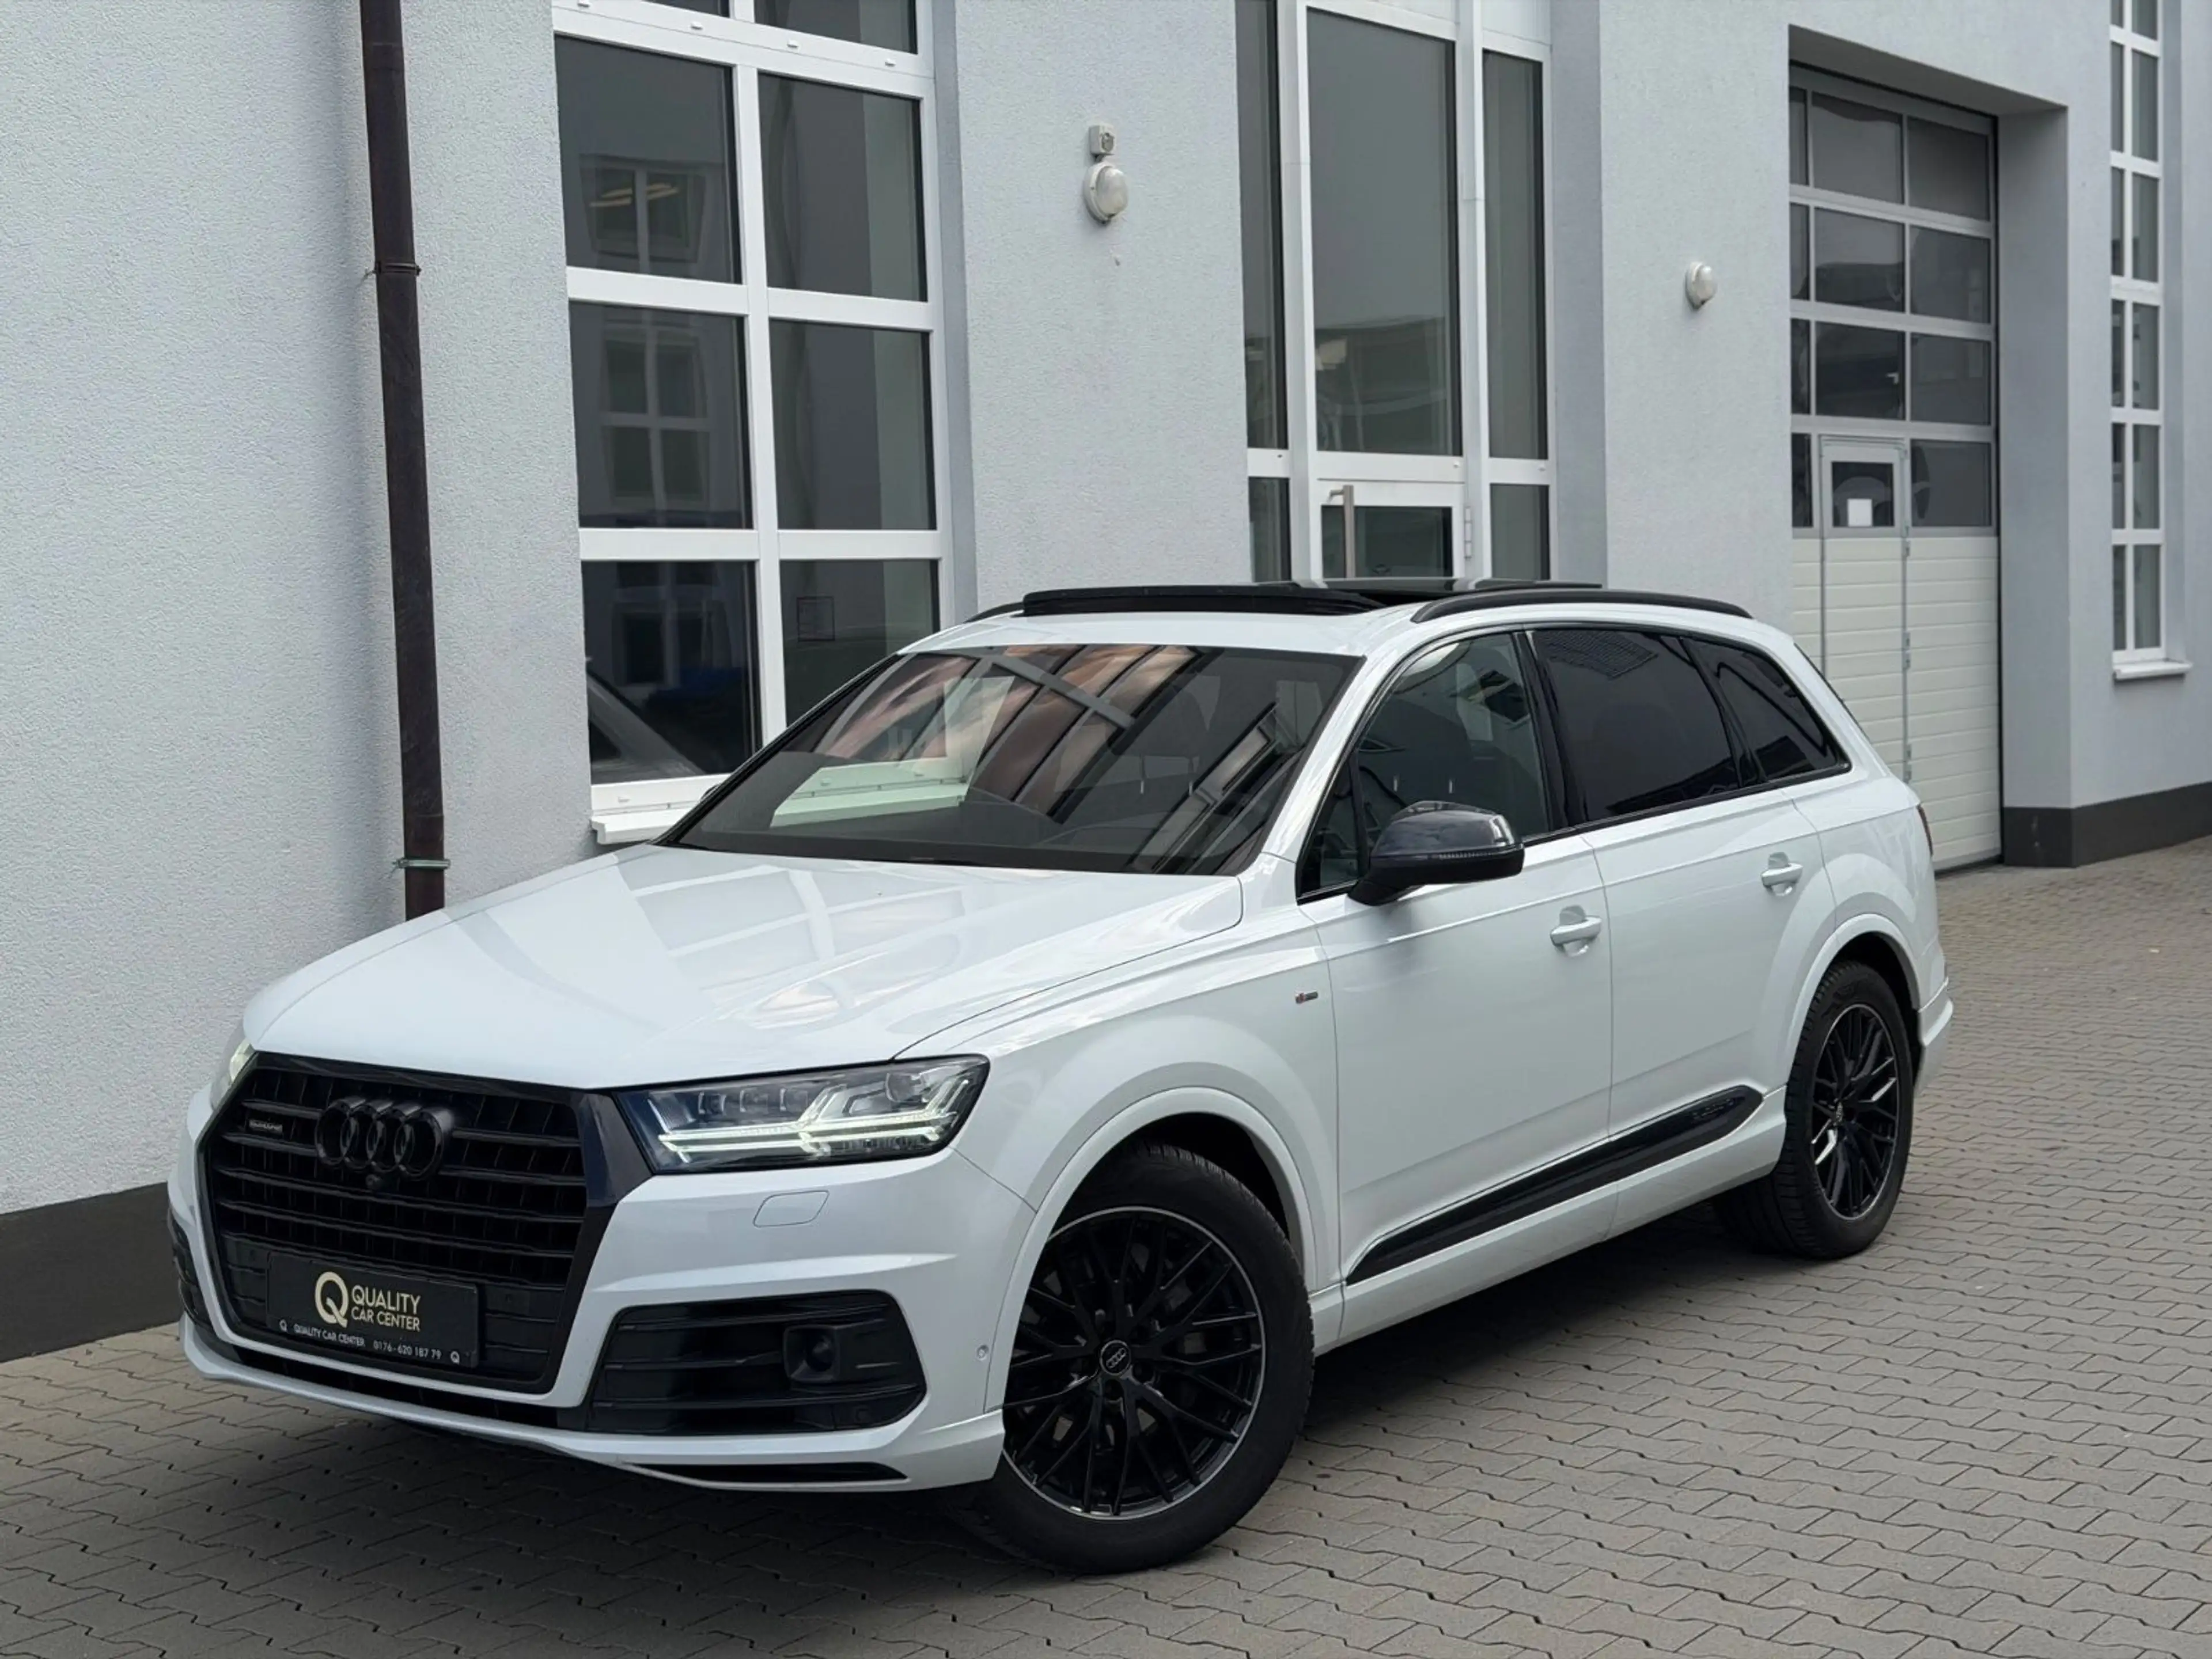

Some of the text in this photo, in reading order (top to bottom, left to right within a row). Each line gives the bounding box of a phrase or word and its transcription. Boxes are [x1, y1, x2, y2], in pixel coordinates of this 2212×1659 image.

[315, 1271, 349, 1328] Q
[351, 1285, 421, 1315] QUALITY
[351, 1306, 421, 1332] CAR CENTER
[279, 1319, 287, 1332] Q
[293, 1323, 321, 1338] QUALITY
[322, 1330, 337, 1342] CAR
[338, 1334, 365, 1347] CENTER
[415, 1346, 429, 1358] 187
[431, 1349, 442, 1359] 79
[450, 1350, 460, 1364] Q
